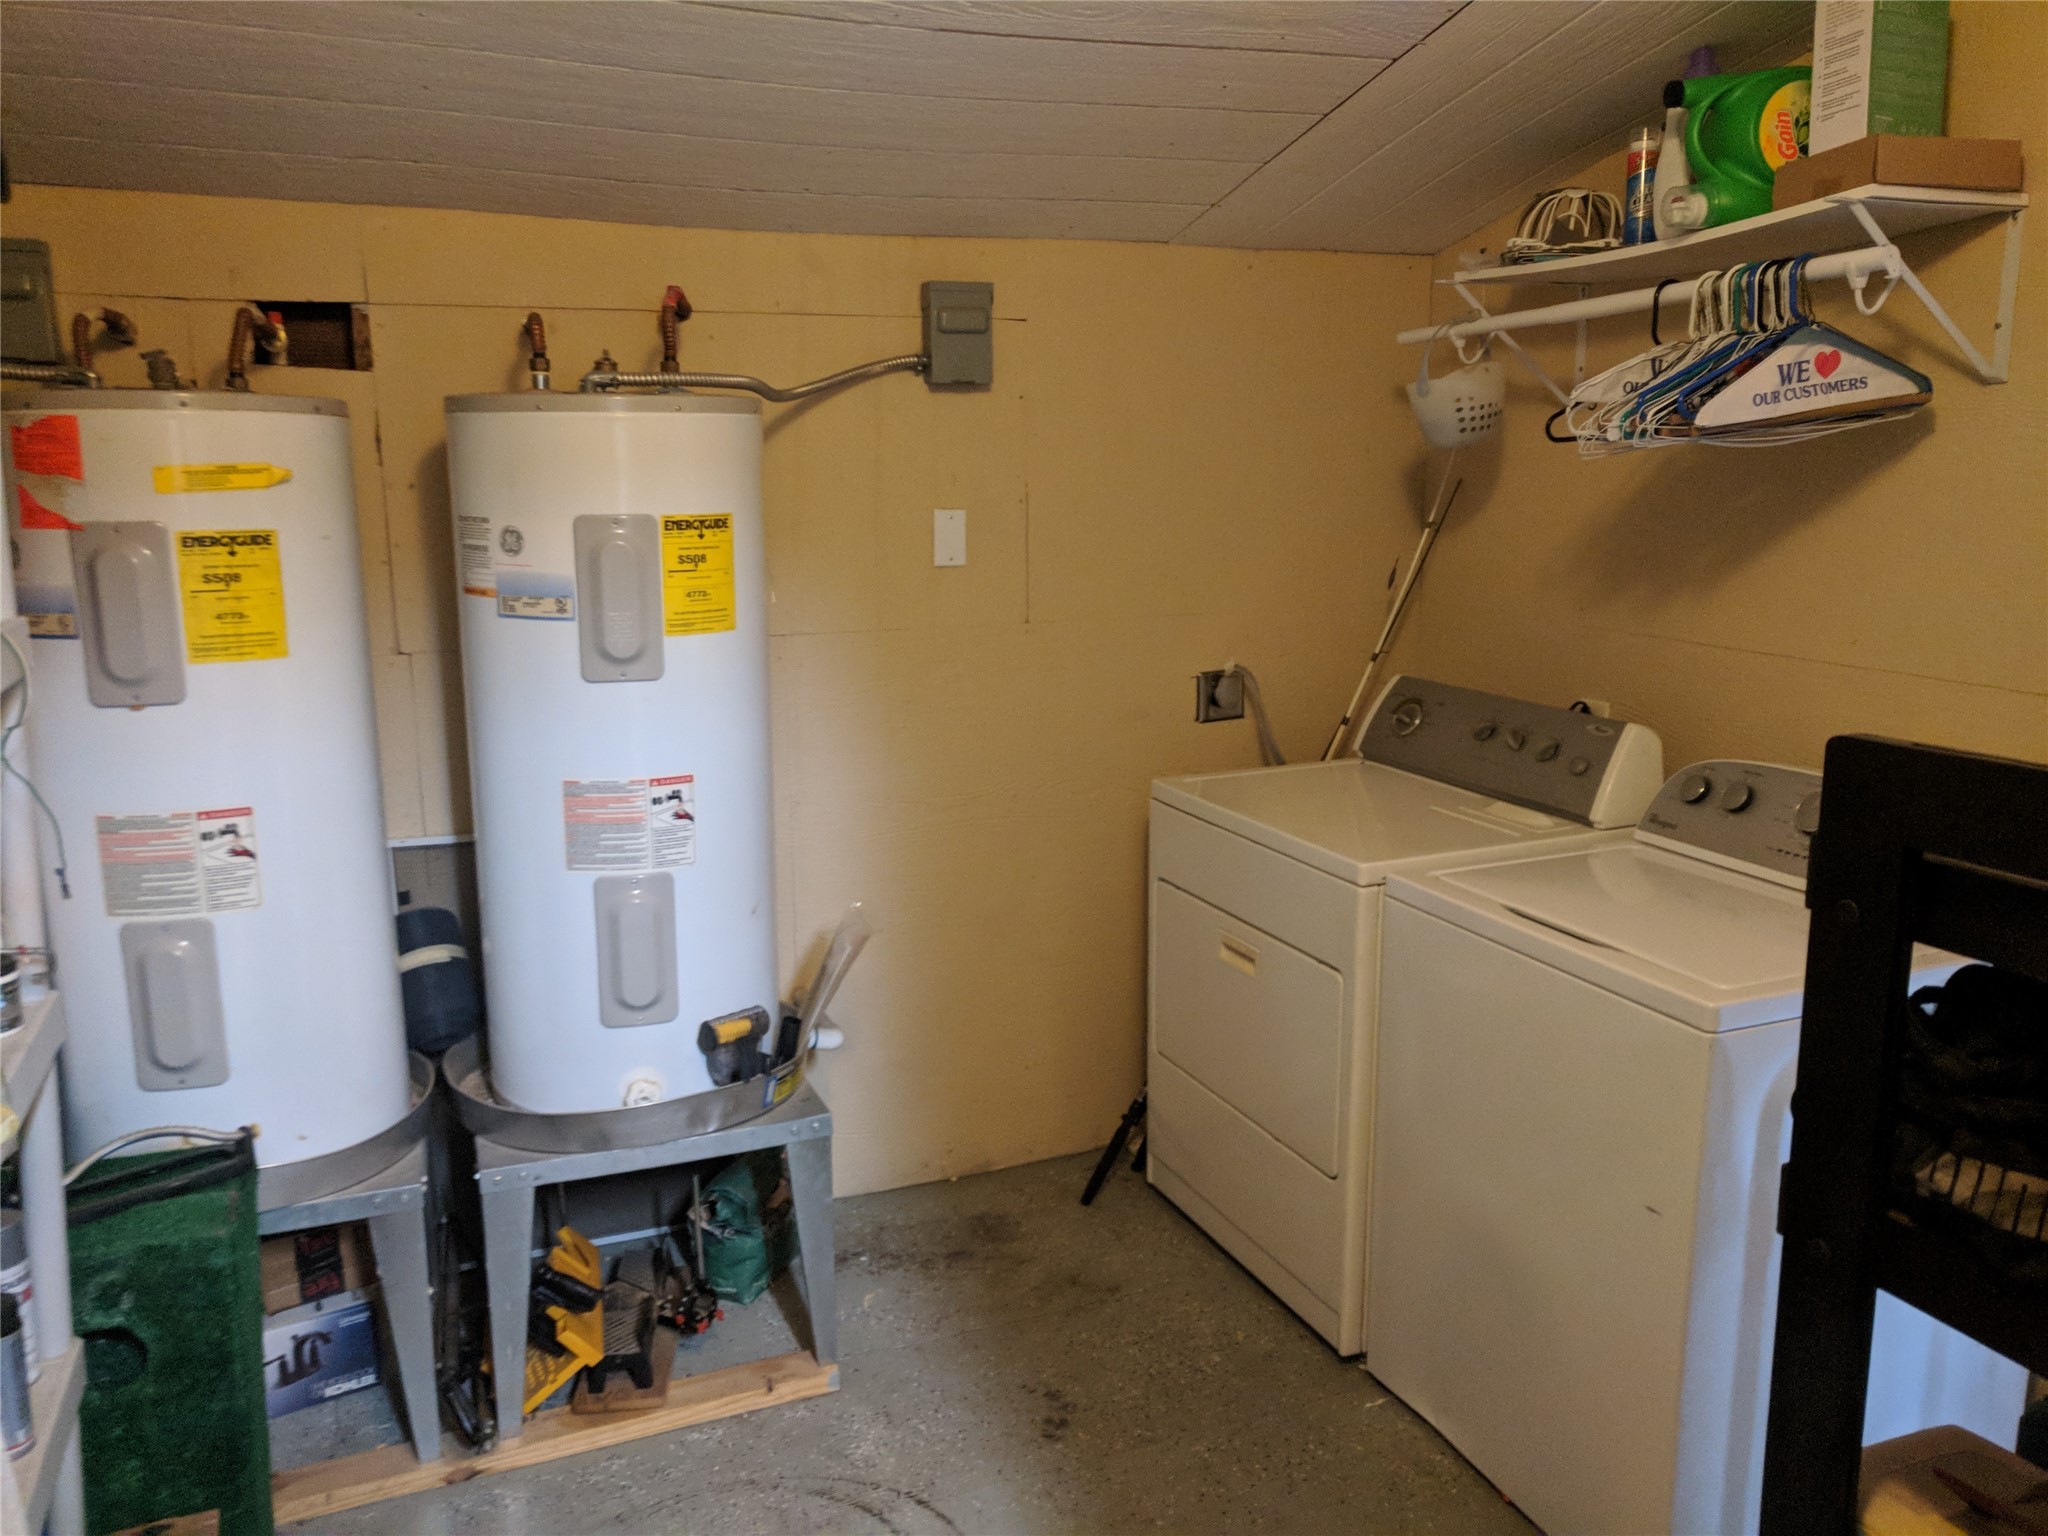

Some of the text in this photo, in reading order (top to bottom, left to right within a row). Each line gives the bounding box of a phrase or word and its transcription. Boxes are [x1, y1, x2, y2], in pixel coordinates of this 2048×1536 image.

[1775, 111, 1799, 160] Gain
[1777, 360, 1810, 386] WE
[1752, 376, 1868, 407] OUR CUSTOMERS
